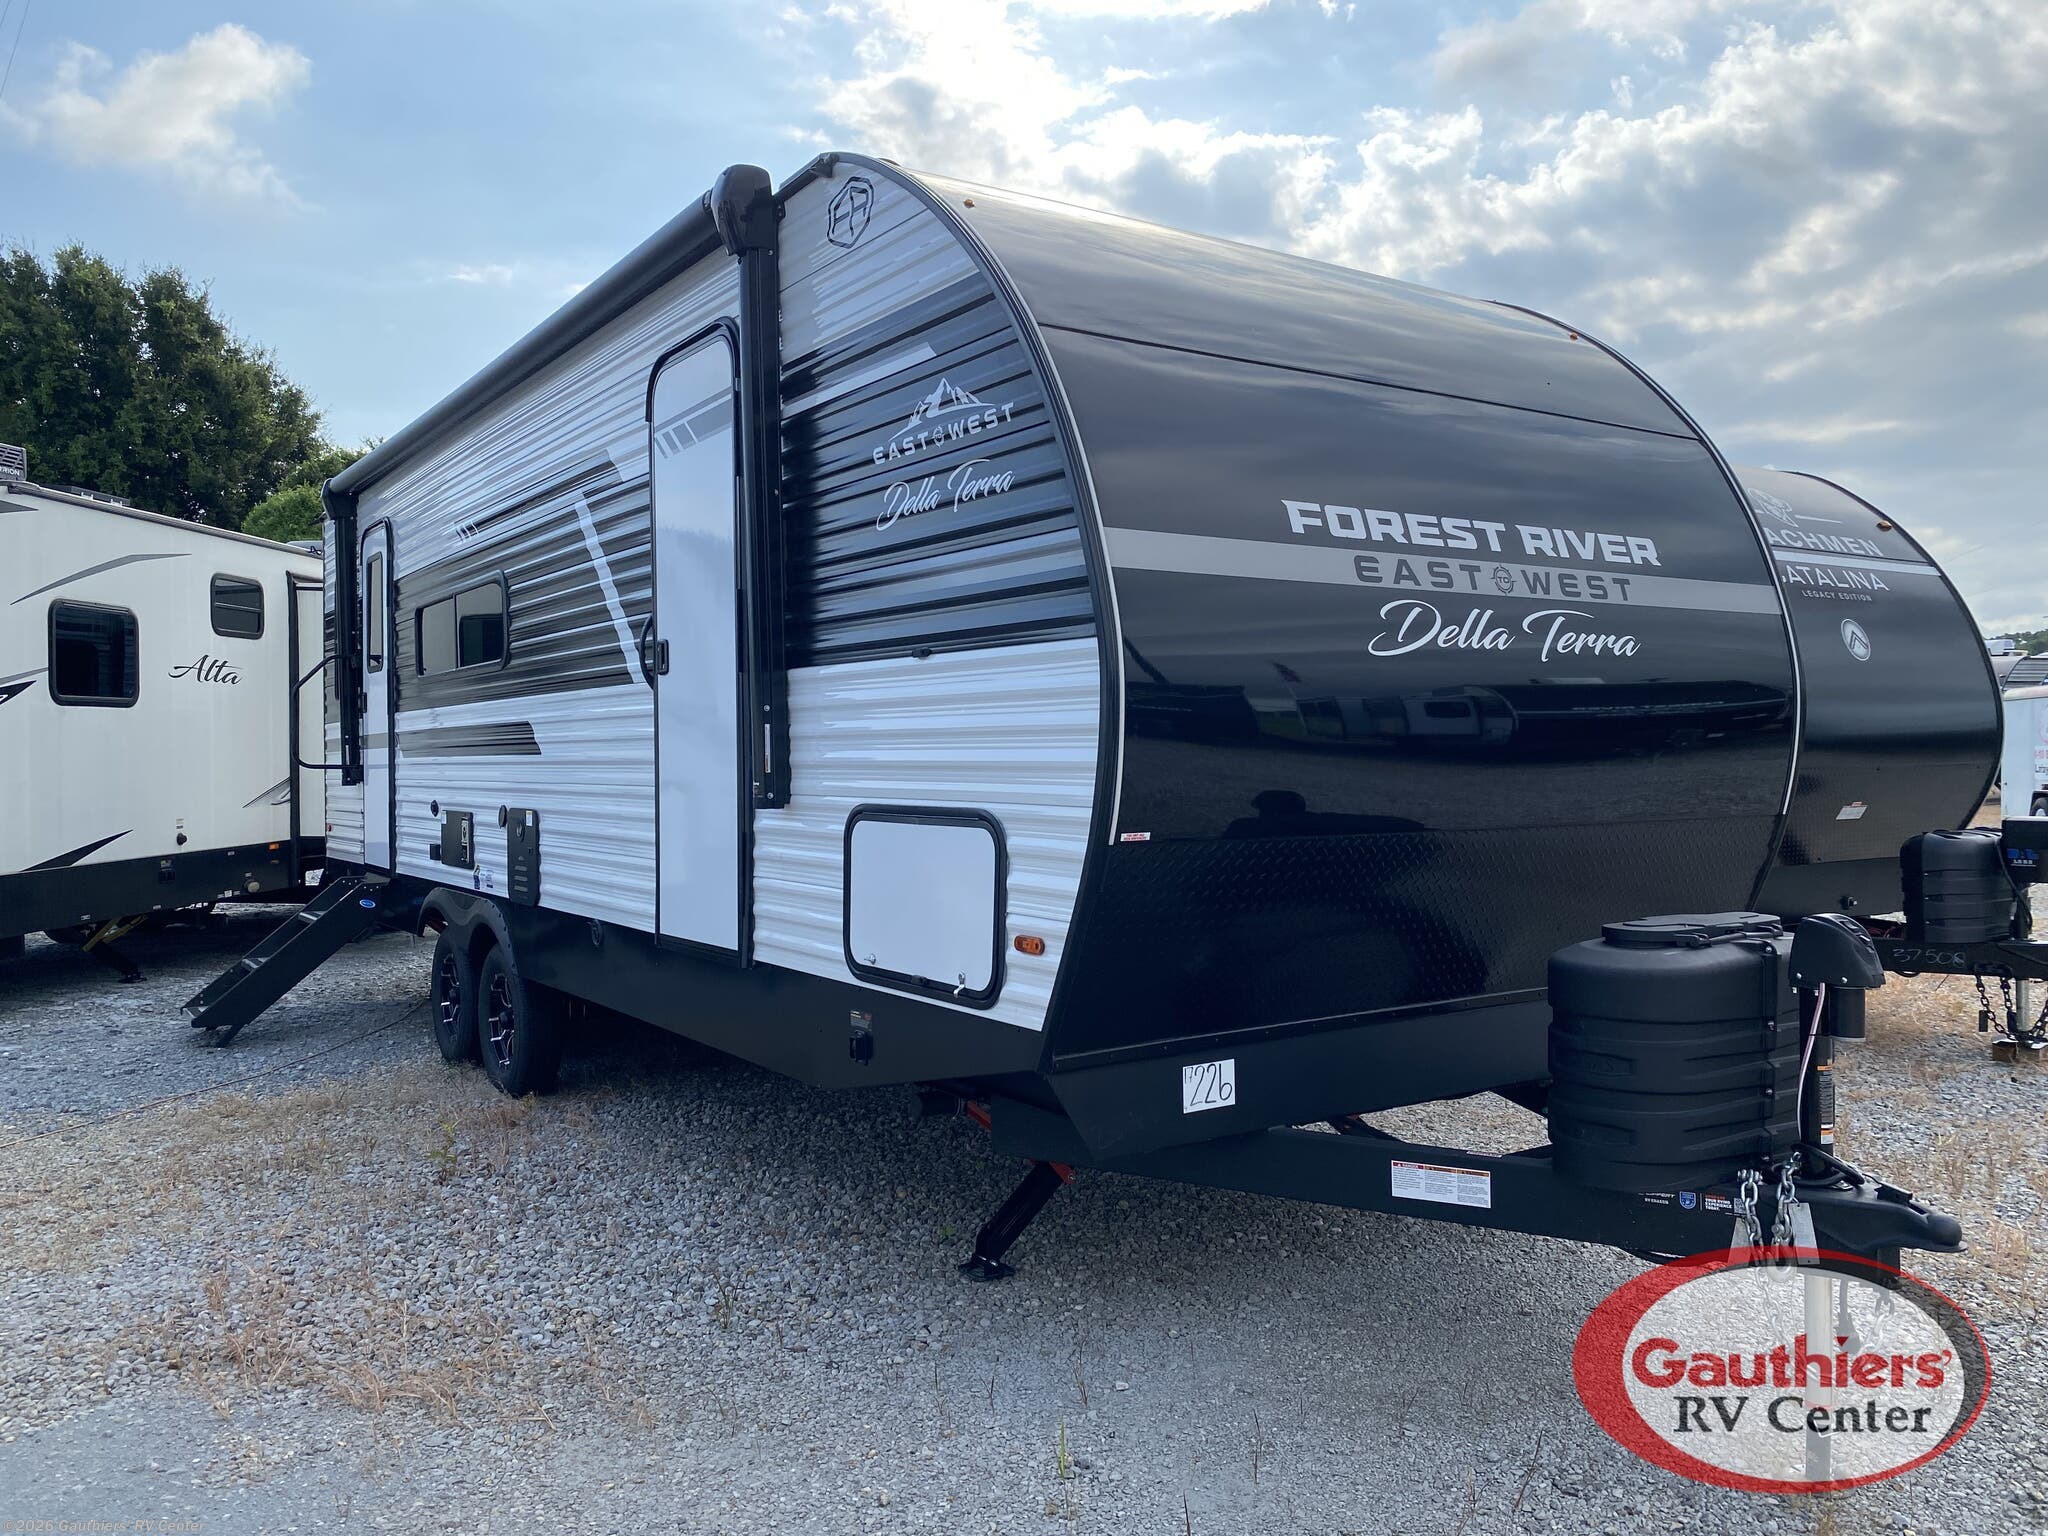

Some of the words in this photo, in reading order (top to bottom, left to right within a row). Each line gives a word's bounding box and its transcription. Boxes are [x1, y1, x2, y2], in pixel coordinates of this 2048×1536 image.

[873, 431, 928, 465] EAST
[948, 402, 1014, 441] WEST
[876, 476, 942, 531] Della
[947, 459, 1015, 513] Terra
[1281, 499, 1505, 552] FOREST
[1515, 524, 1662, 566] RIVER
[1353, 554, 1482, 591] EAST
[1520, 569, 1631, 602] WEST
[1781, 564, 1891, 592] ATALINA
[1802, 590, 1836, 599] LEGACY
[1838, 592, 1872, 602] EDITION
[1368, 599, 1515, 656] Della
[1522, 609, 1641, 662] Terra
[168, 654, 244, 685] Alta
